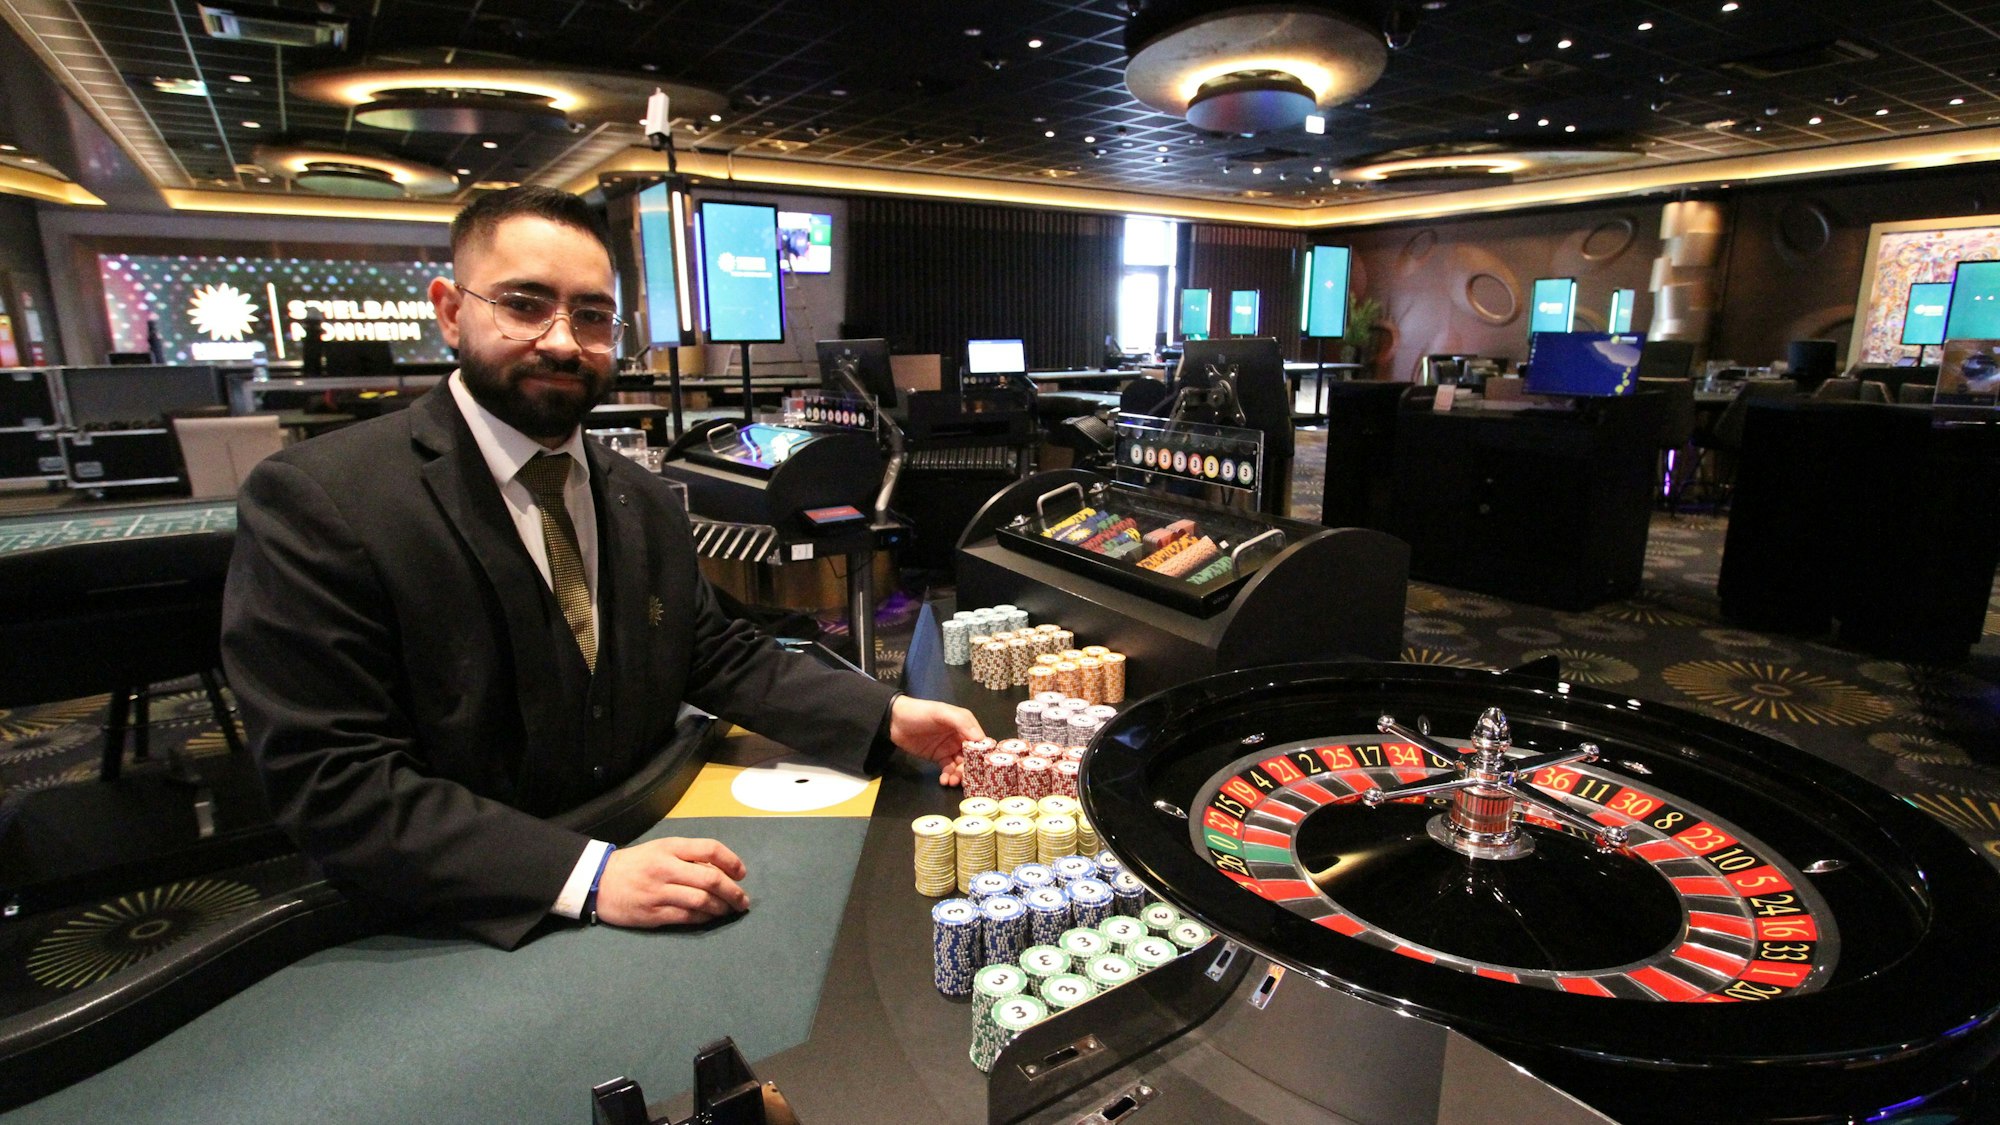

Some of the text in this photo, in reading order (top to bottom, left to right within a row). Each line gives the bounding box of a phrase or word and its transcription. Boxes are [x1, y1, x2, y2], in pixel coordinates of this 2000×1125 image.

[1298, 753, 1322, 774] 2
[1322, 748, 1353, 769] 25
[1356, 746, 1382, 766] 17
[1389, 746, 1419, 766] 34
[1250, 770, 1274, 789] 4
[1268, 759, 1302, 782] 21
[1536, 767, 1576, 790] 36
[1227, 780, 1257, 805] 19
[1577, 779, 1610, 803] 11
[1215, 794, 1246, 819] 15
[1610, 792, 1653, 816] 30
[1208, 811, 1239, 836] 32
[1654, 811, 1684, 830] 8
[1208, 834, 1238, 850] 0
[1678, 827, 1726, 851] 23
[1211, 850, 1249, 876] 26
[1708, 847, 1755, 871] 10
[1736, 876, 1779, 888] 5
[1750, 894, 1801, 916] 24
[1154, 912, 1168, 920] 3
[1116, 924, 1130, 935] 3
[1182, 928, 1198, 939] 3
[1762, 919, 1810, 937] 16
[1077, 937, 1092, 948] 3
[1144, 945, 1161, 957] 3
[1761, 942, 1810, 961] 33
[1039, 954, 1052, 966] 3
[1103, 963, 1122, 974] 3
[992, 974, 1009, 986] 3
[1751, 968, 1799, 977] 1
[1058, 985, 1078, 995] 3
[1011, 1006, 1027, 1019] 3
